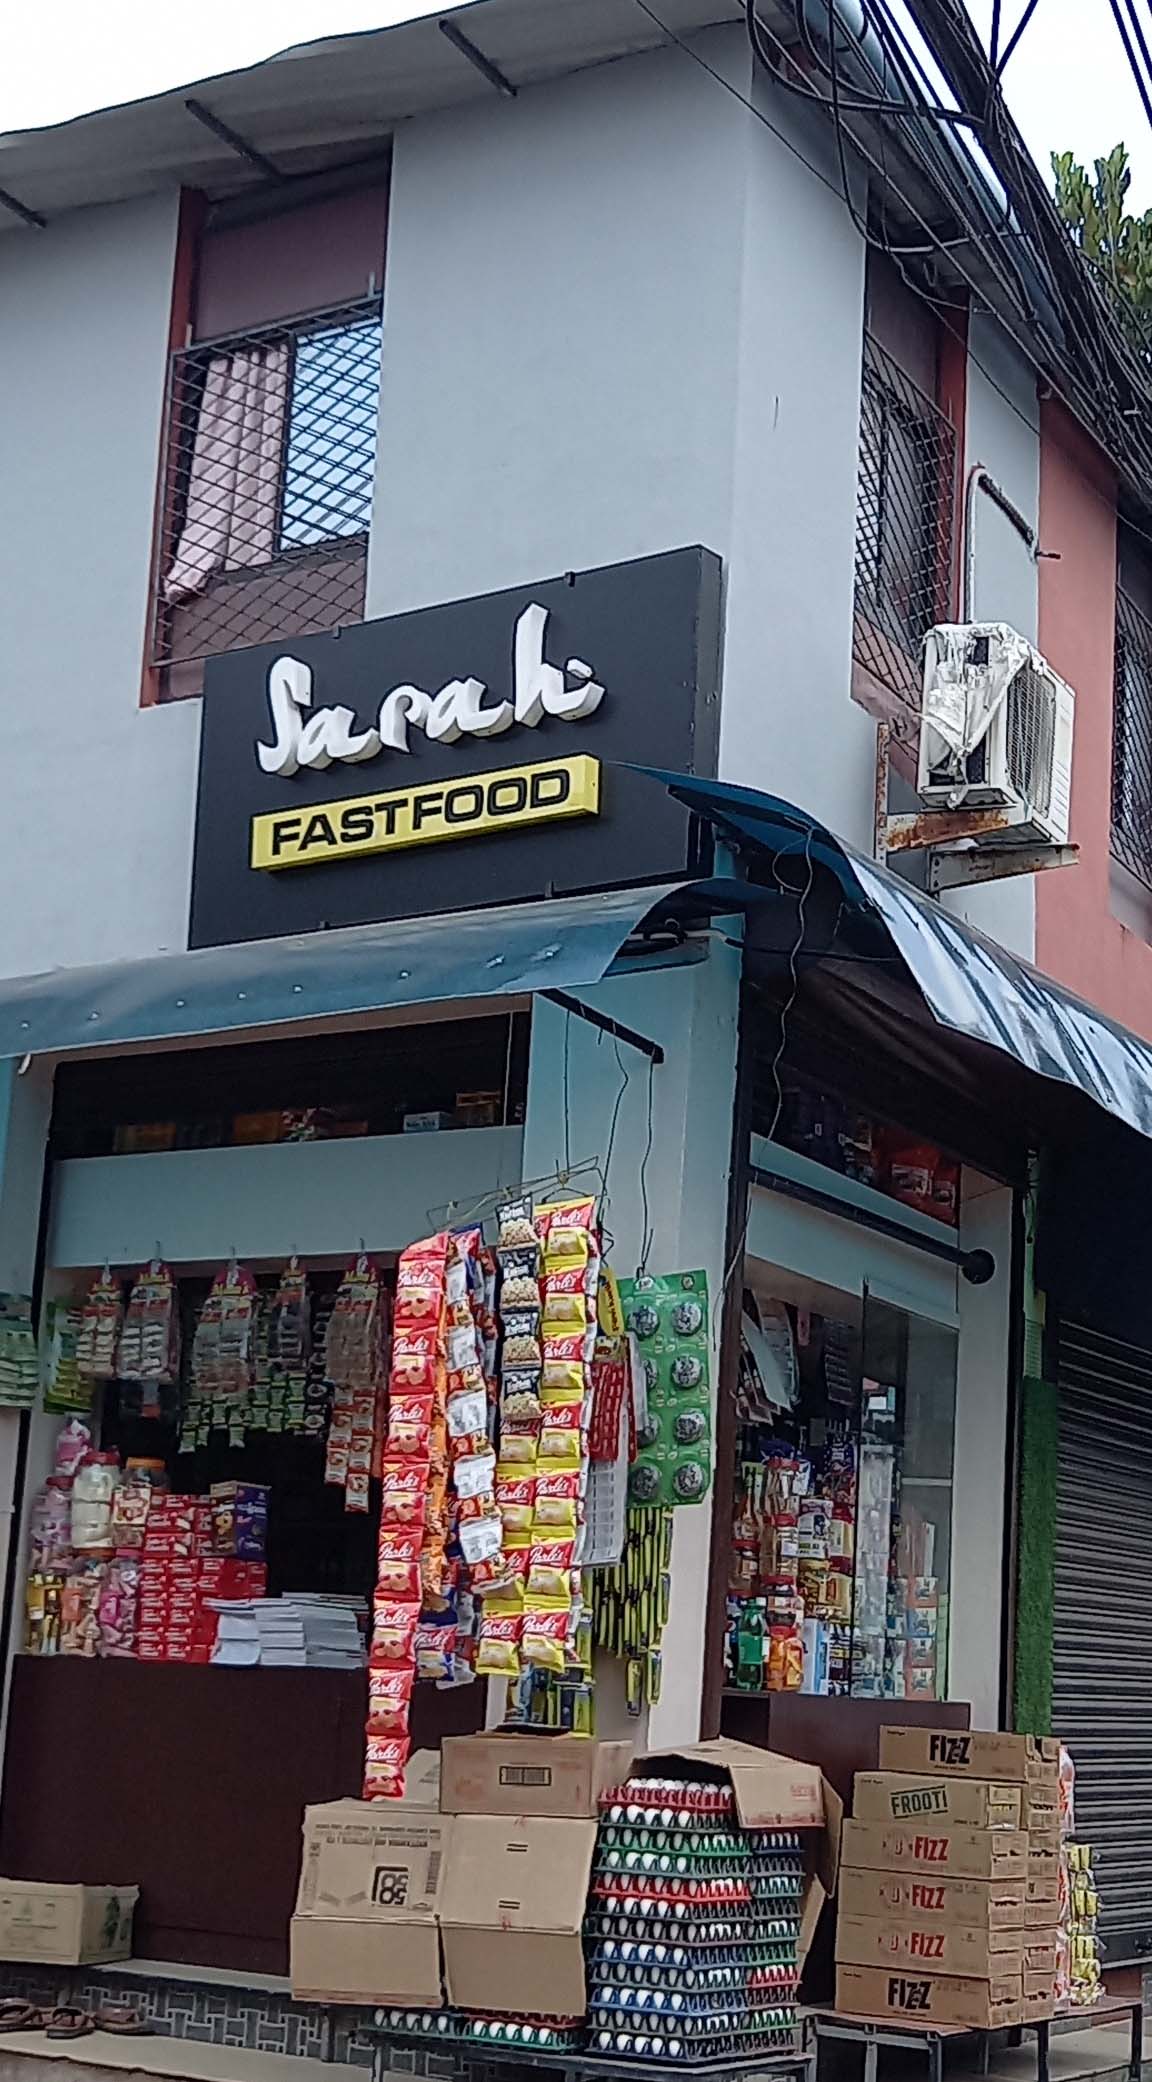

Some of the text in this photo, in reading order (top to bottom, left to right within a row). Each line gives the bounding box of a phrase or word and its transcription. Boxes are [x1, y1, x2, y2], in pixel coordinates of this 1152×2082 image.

[271, 768, 570, 856] FASTFOOD
[929, 1735, 971, 1765] FIZZ
[890, 1790, 948, 1815] FROOTI
[914, 1836, 949, 1861] FIZZ
[912, 1884, 946, 1909] FIZZ
[910, 1932, 945, 1957] FIZZ
[887, 1977, 932, 2010] FIZZ
